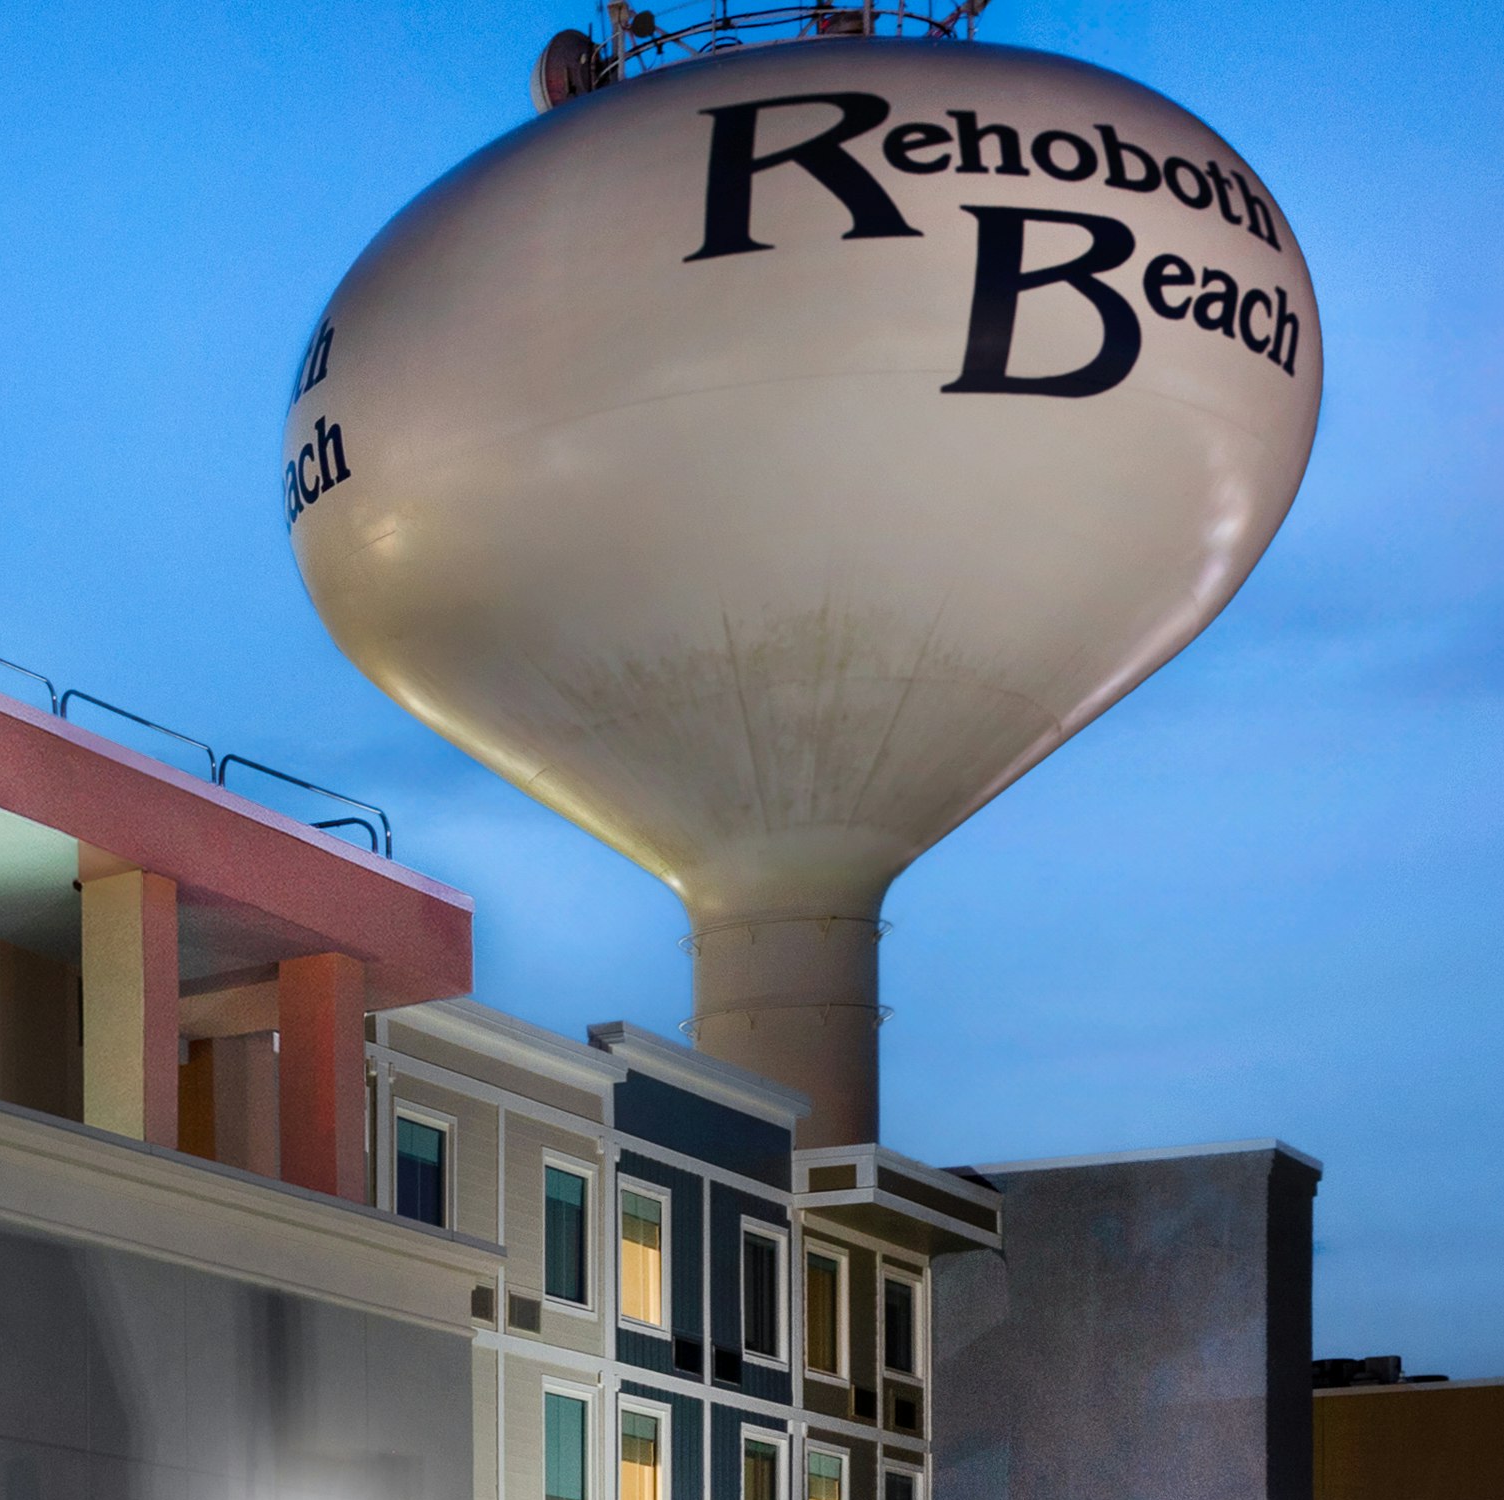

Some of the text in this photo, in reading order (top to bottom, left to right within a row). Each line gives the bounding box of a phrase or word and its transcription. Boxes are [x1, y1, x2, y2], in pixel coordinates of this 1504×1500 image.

[682, 90, 1283, 262] Rehoboth
[940, 203, 1300, 398] Beach
[283, 415, 351, 526] ach
